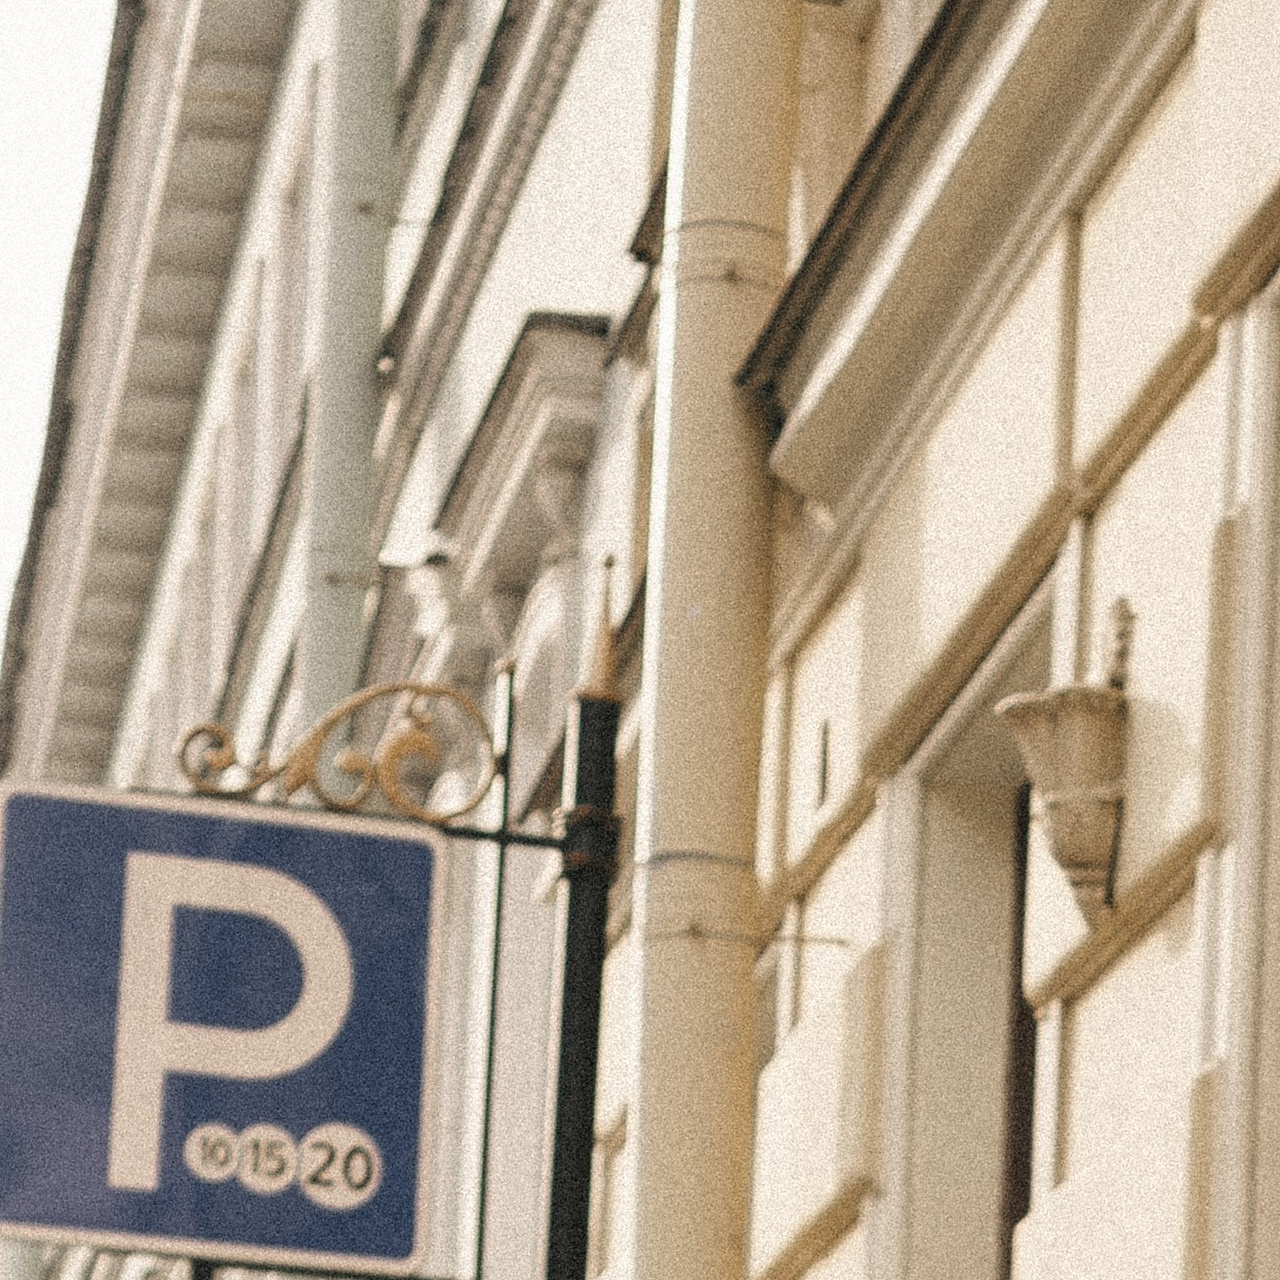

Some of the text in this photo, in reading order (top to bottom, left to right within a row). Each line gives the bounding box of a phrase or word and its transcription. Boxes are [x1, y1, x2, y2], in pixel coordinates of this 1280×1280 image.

[107, 851, 354, 1192] P
[252, 1138, 287, 1178] 15
[309, 1140, 373, 1190] 20
